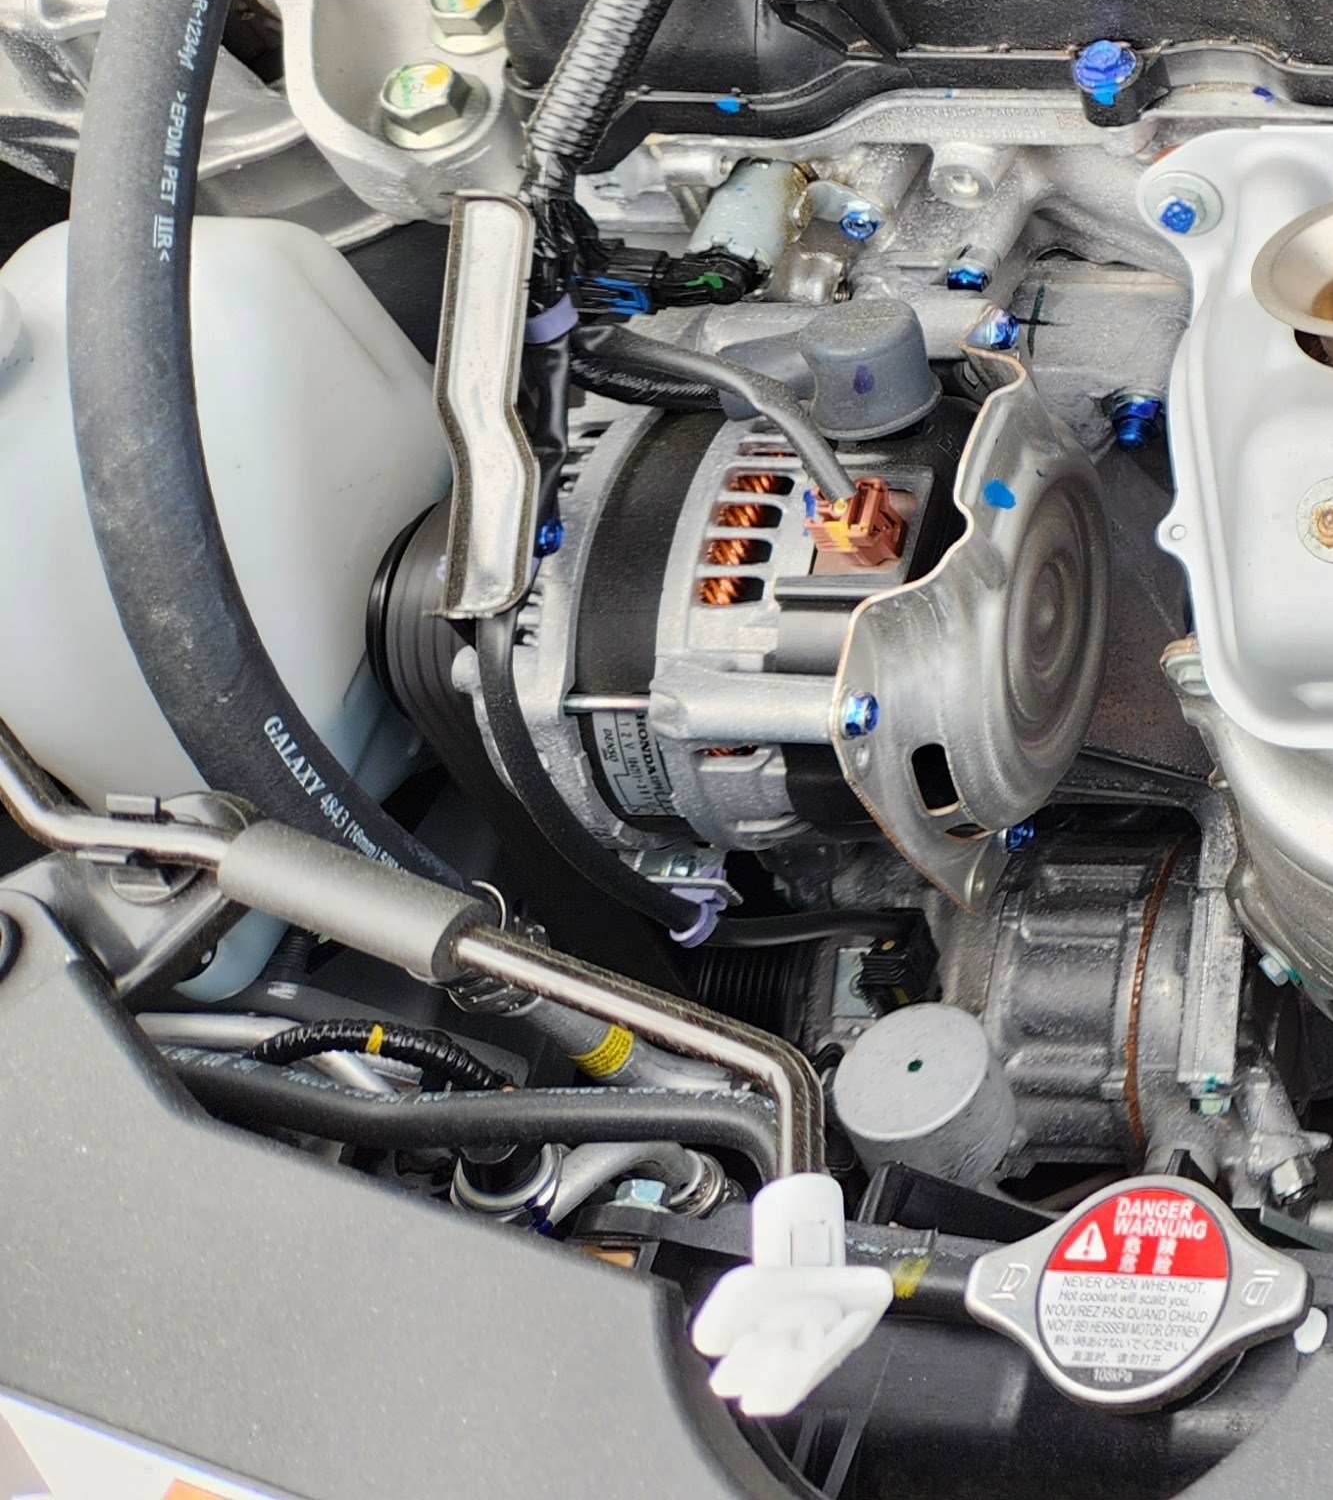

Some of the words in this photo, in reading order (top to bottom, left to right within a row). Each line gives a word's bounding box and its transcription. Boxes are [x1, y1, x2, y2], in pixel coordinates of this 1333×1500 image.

[160, 164, 180, 206] PET
[603, 728, 619, 762] DENSO
[636, 712, 657, 775] HONDA
[264, 715, 326, 796] GALAXY
[320, 793, 349, 829] 4843
[1116, 1196, 1197, 1220] DANGER
[1114, 1216, 1208, 1240] WARNUNG
[1059, 1289, 1078, 1301] Hot
[1080, 1291, 1118, 1304] coolant
[1062, 1275, 1101, 1289] NEVER
[1105, 1277, 1137, 1290] OPEN
[1141, 1279, 1177, 1292] WHEN
[1178, 1281, 1206, 1294] HOT.
[1102, 1305, 1125, 1319] PAS
[1127, 1307, 1167, 1321] QUAND
[1169, 1309, 1208, 1324] CHAUD
[1131, 1322, 1164, 1336] MOTOR
